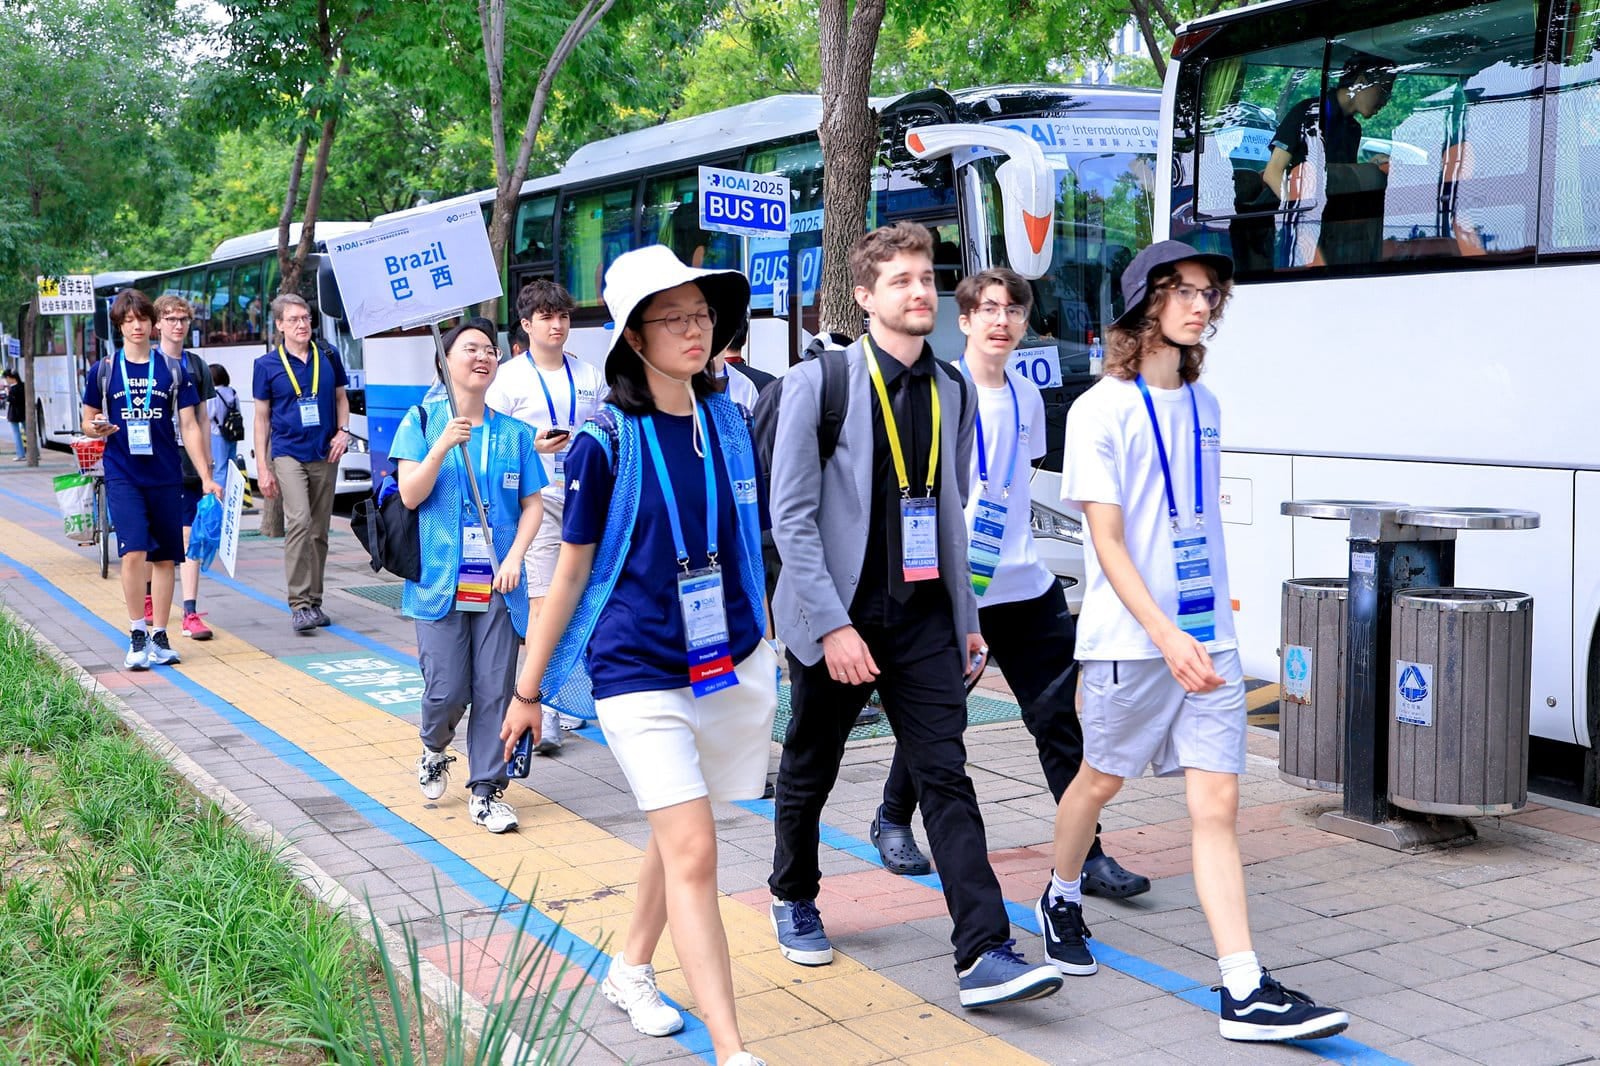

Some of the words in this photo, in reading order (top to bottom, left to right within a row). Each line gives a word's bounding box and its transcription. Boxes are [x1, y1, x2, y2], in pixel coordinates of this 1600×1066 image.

[1073, 125, 1140, 137] International
[722, 175, 750, 191] IOAI
[752, 180, 784, 196] 2025
[709, 195, 755, 222] BUS
[760, 203, 783, 225] 10
[794, 216, 820, 232] 2025
[385, 241, 447, 276] Brazil
[752, 255, 788, 286] BUS
[1016, 358, 1051, 386] 10
[692, 634, 724, 648] VOLUNTEER
